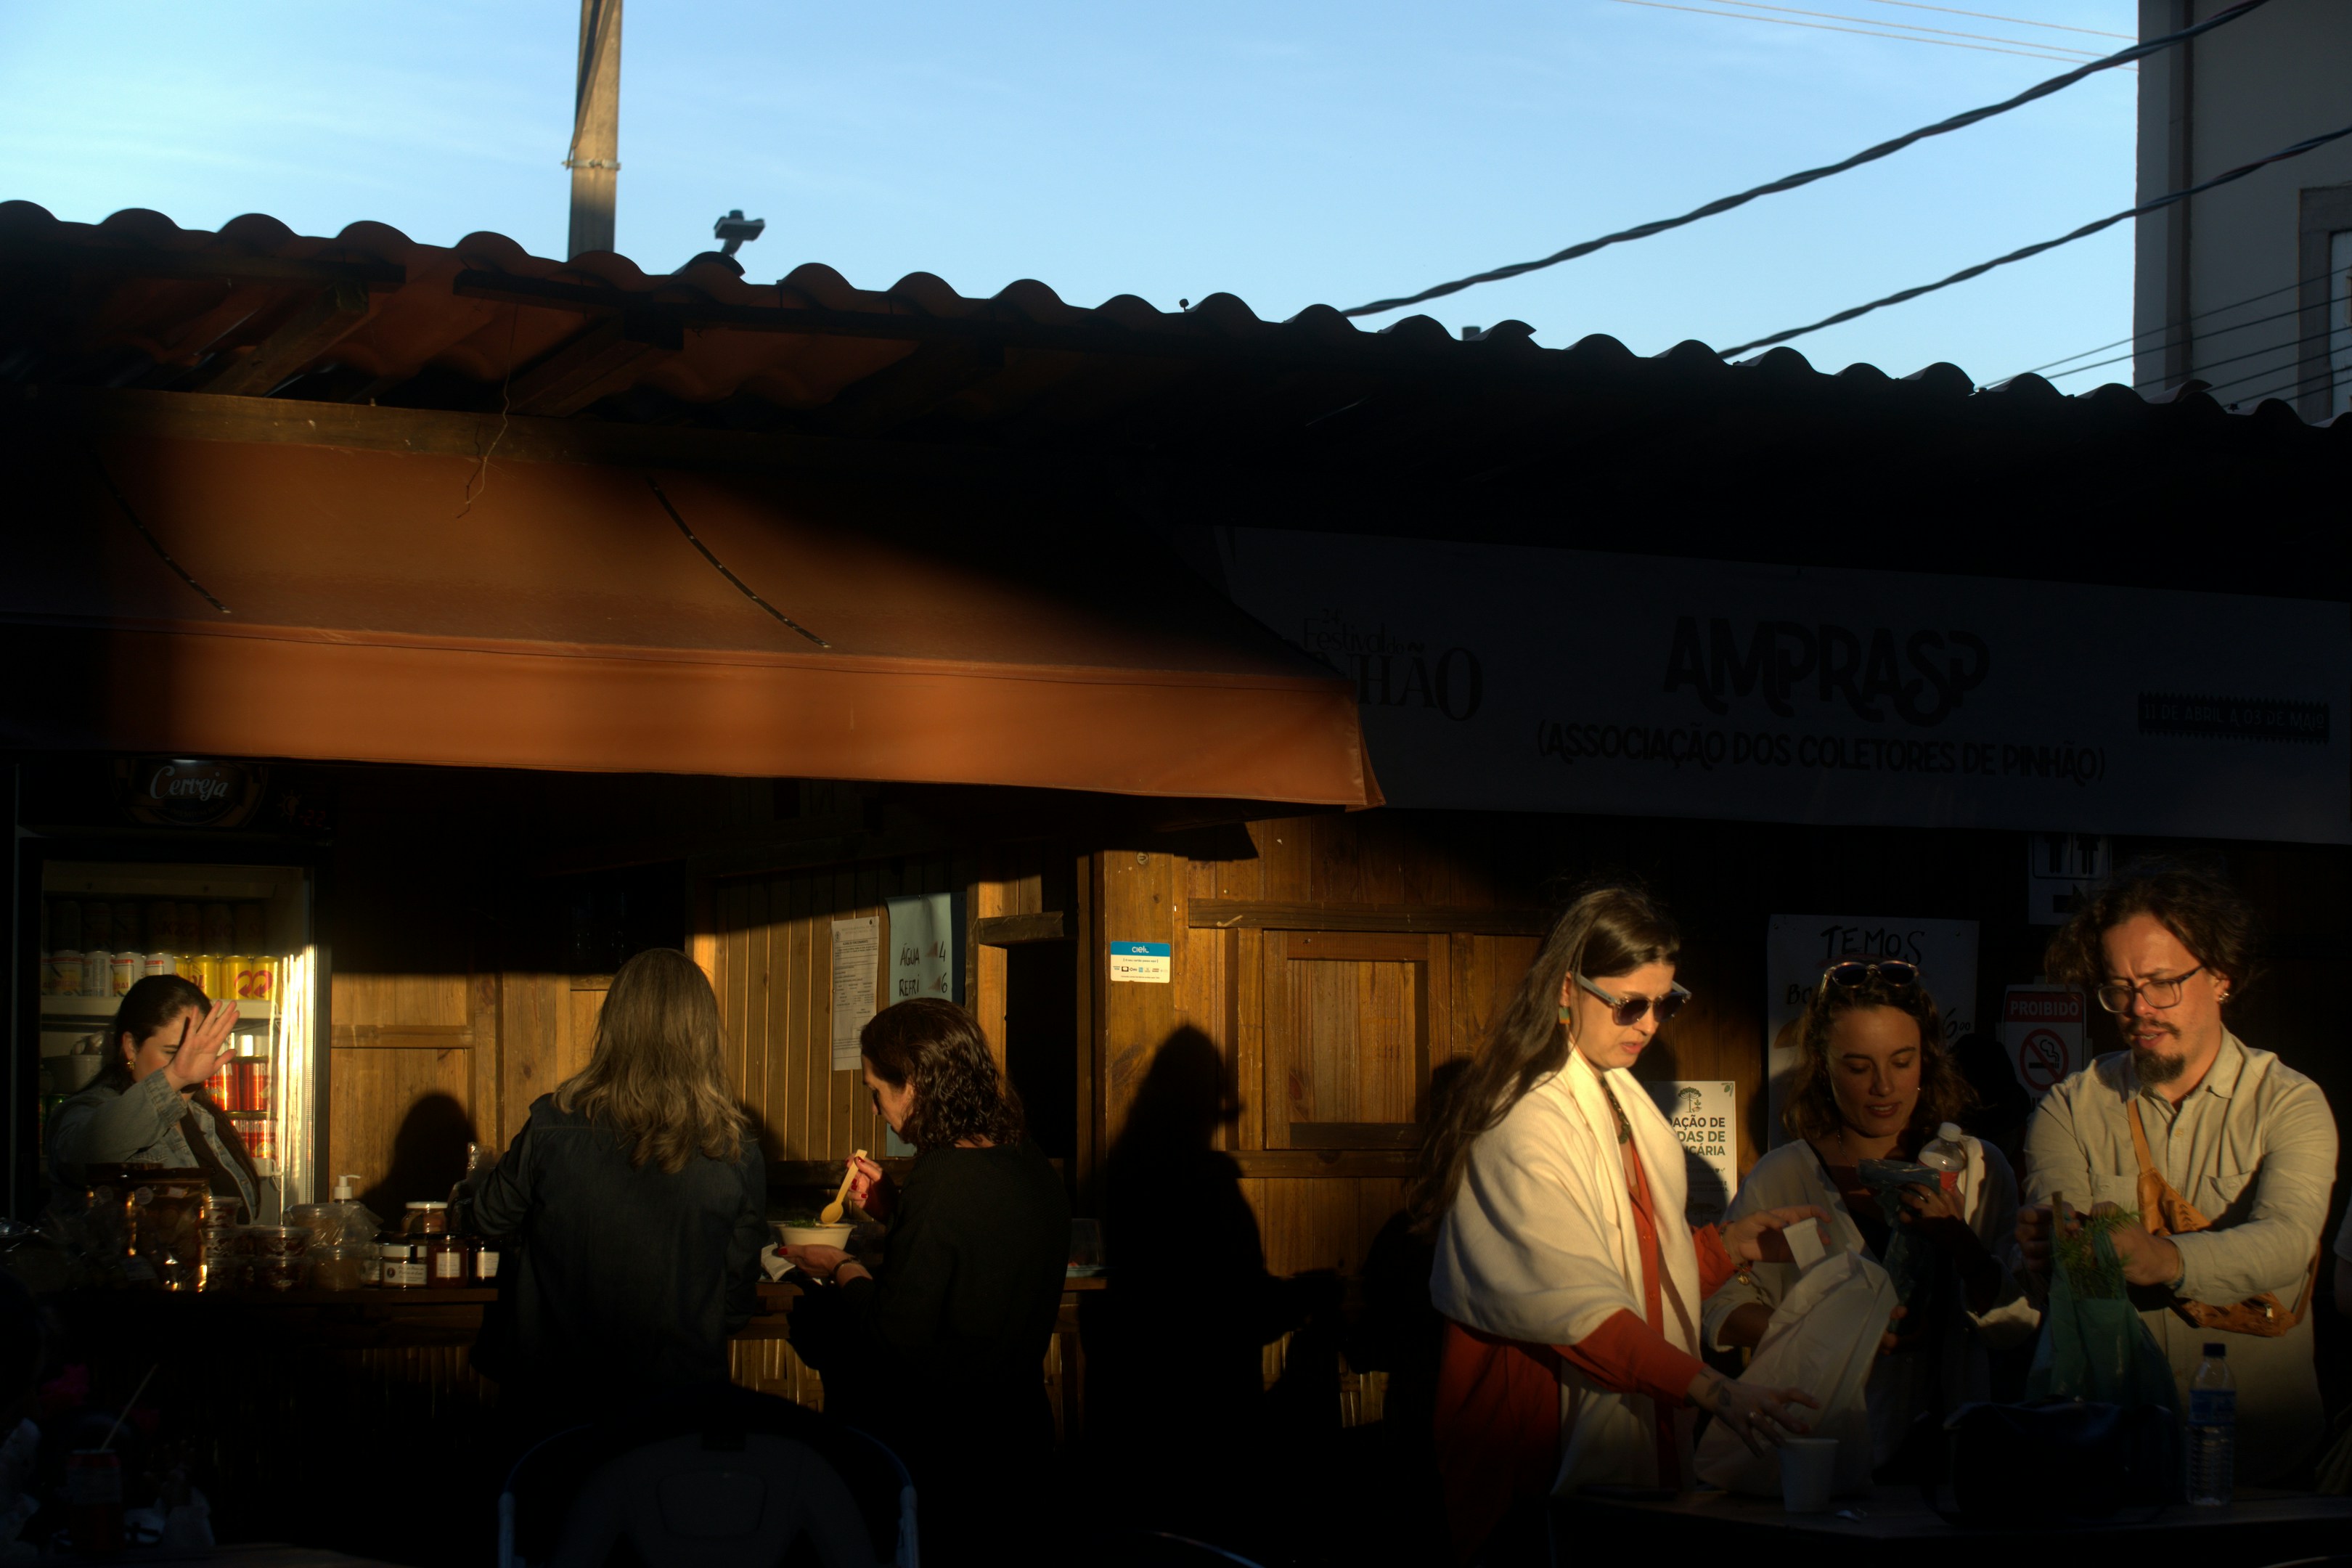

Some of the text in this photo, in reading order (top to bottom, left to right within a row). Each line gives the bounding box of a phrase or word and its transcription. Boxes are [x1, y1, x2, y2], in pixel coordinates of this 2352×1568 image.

[1304, 618, 1405, 655] Festival do
[1662, 616, 1990, 727] AMPRASP
[2161, 704, 2179, 720] DE
[2184, 705, 2224, 723] ABRIL
[2229, 709, 2242, 727] A
[2242, 709, 2263, 725] 03
[2265, 709, 2286, 727] DE
[1538, 719, 2105, 787] (ASSOCIAÇÃO DOS COLETORES DE PINHÃO)
[150, 765, 229, 801] Cerveja
[899, 942, 920, 966] ÁGUA
[939, 941, 946, 962] 4
[1820, 924, 1925, 965] TEMOS
[941, 972, 948, 994] 6
[2009, 1000, 2079, 1016] PROIBIDO
[1710, 1117, 1726, 1127] DE
[1677, 1130, 1726, 1143] DAS DE
